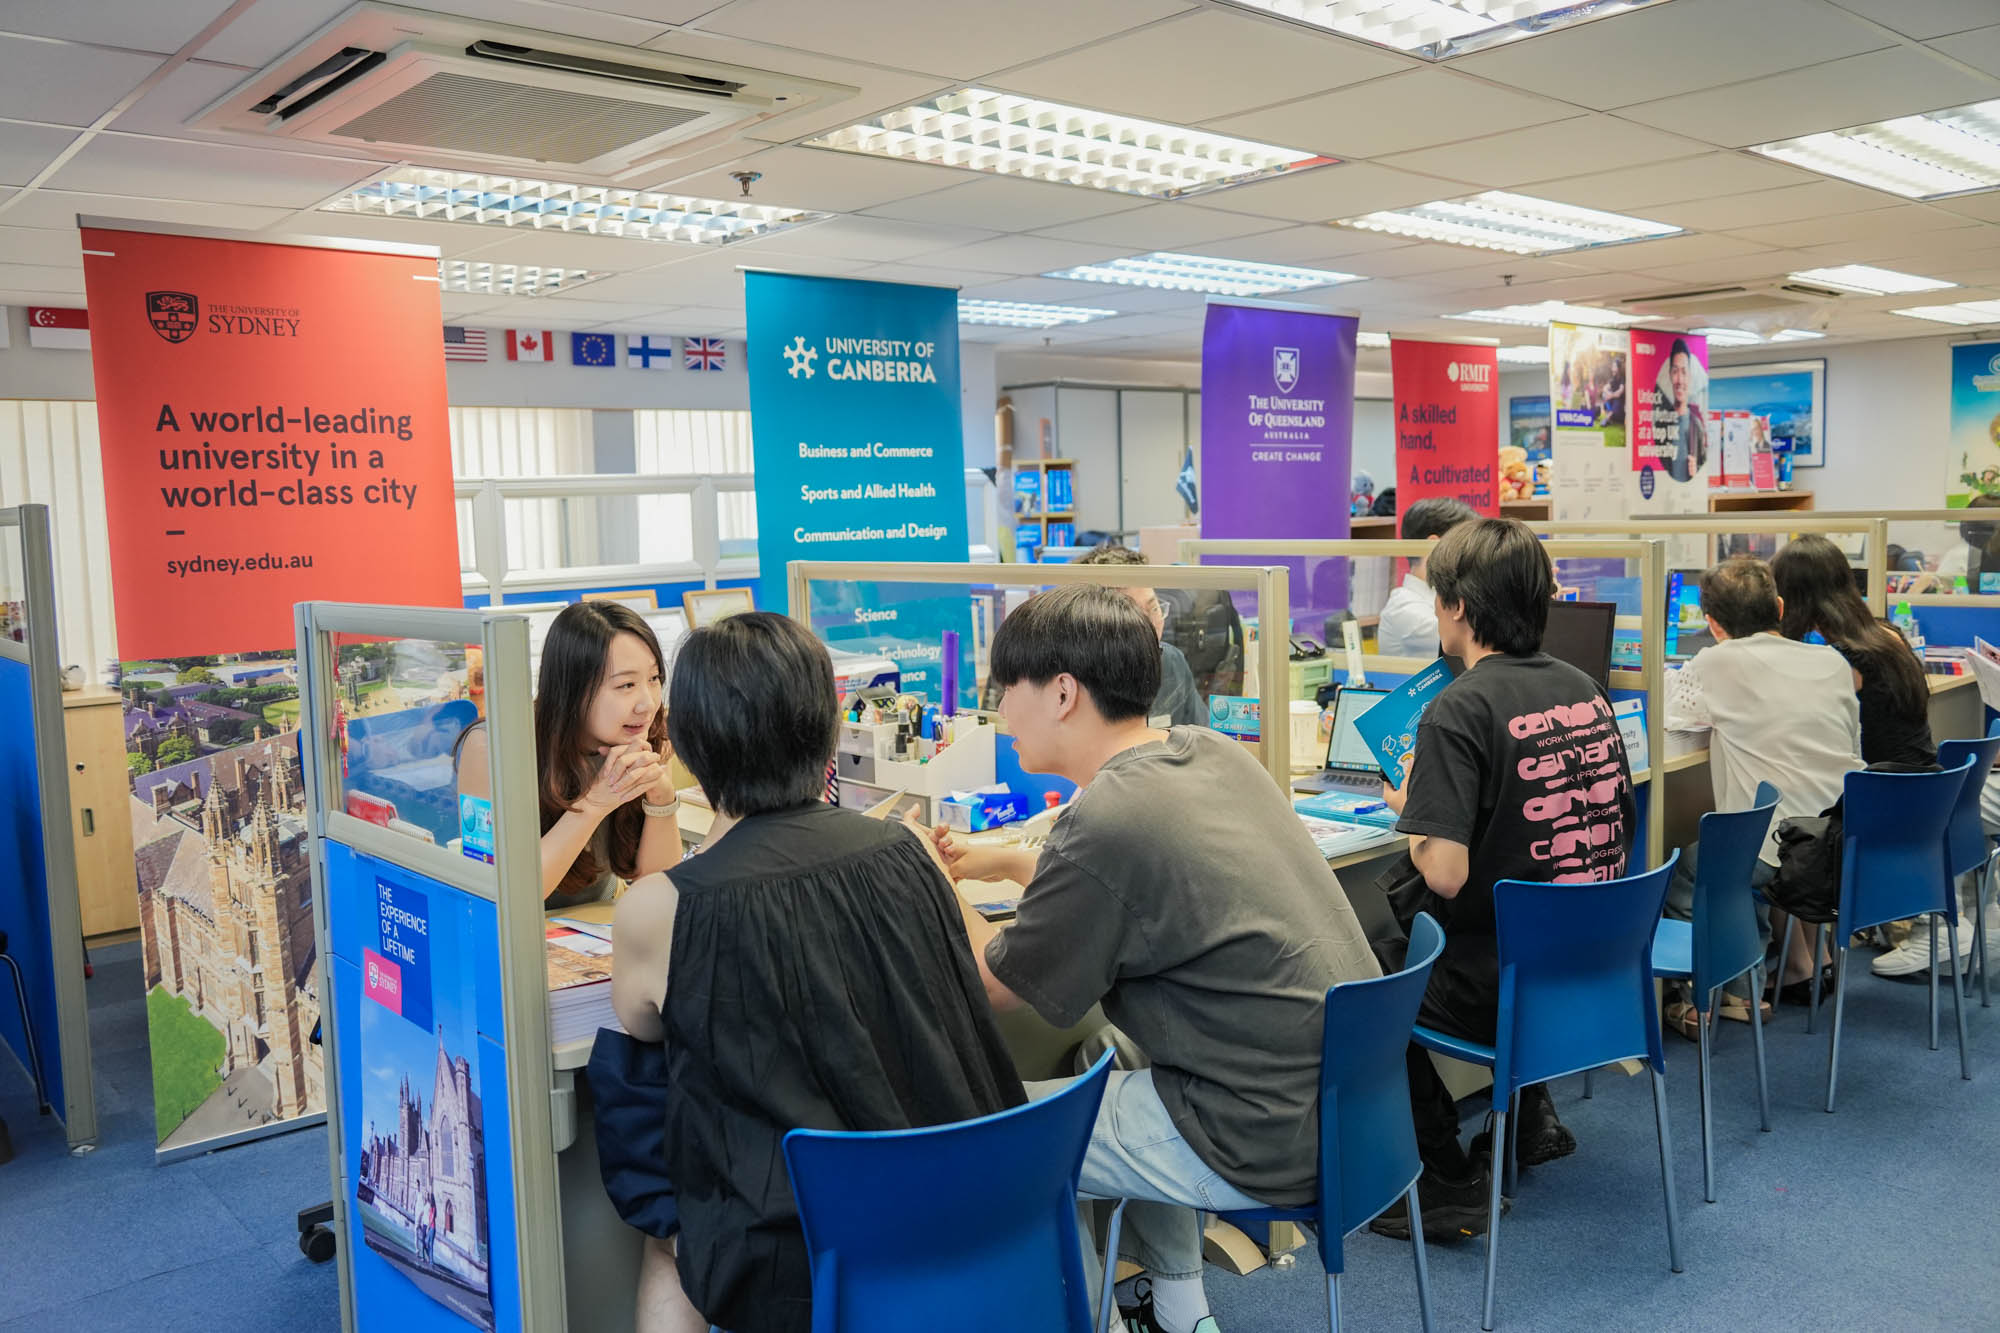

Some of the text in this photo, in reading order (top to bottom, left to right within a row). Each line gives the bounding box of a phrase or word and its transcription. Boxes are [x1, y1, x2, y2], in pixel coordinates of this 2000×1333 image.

[208, 304, 300, 317] THE UNIVERSITY OF
[208, 314, 300, 337] SYDNEY
[826, 337, 935, 358] UNIVERSITY OF
[827, 358, 937, 384] CANBERRA
[1460, 363, 1491, 382] RMIT
[1270, 396, 1325, 412] UNIVERSITY
[1400, 403, 1457, 424] A skilled
[156, 404, 413, 441] A world-leading
[1264, 412, 1326, 429] QUEENSLAND
[1264, 431, 1310, 440] AUSTRALIA
[1400, 429, 1437, 453] hand,
[159, 442, 385, 476] university in a
[798, 443, 933, 458] Business and Commerce
[1252, 451, 1322, 462] CREATE CHANGE
[1410, 464, 1490, 485] A cultivated
[161, 478, 417, 510] world-class city
[801, 483, 936, 504] Sports and Allied Health
[1458, 488, 1490, 508] mind
[794, 523, 947, 543] Communication and Design
[167, 553, 314, 578] sydney.edu.au
[854, 608, 897, 623] Science
[878, 643, 942, 662] Technology
[1536, 735, 1564, 749] WORK
[378, 884, 393, 903] THE
[380, 902, 427, 936] EXPERIENCE
[381, 919, 400, 939] OF A
[382, 936, 416, 965] LIFETIME
